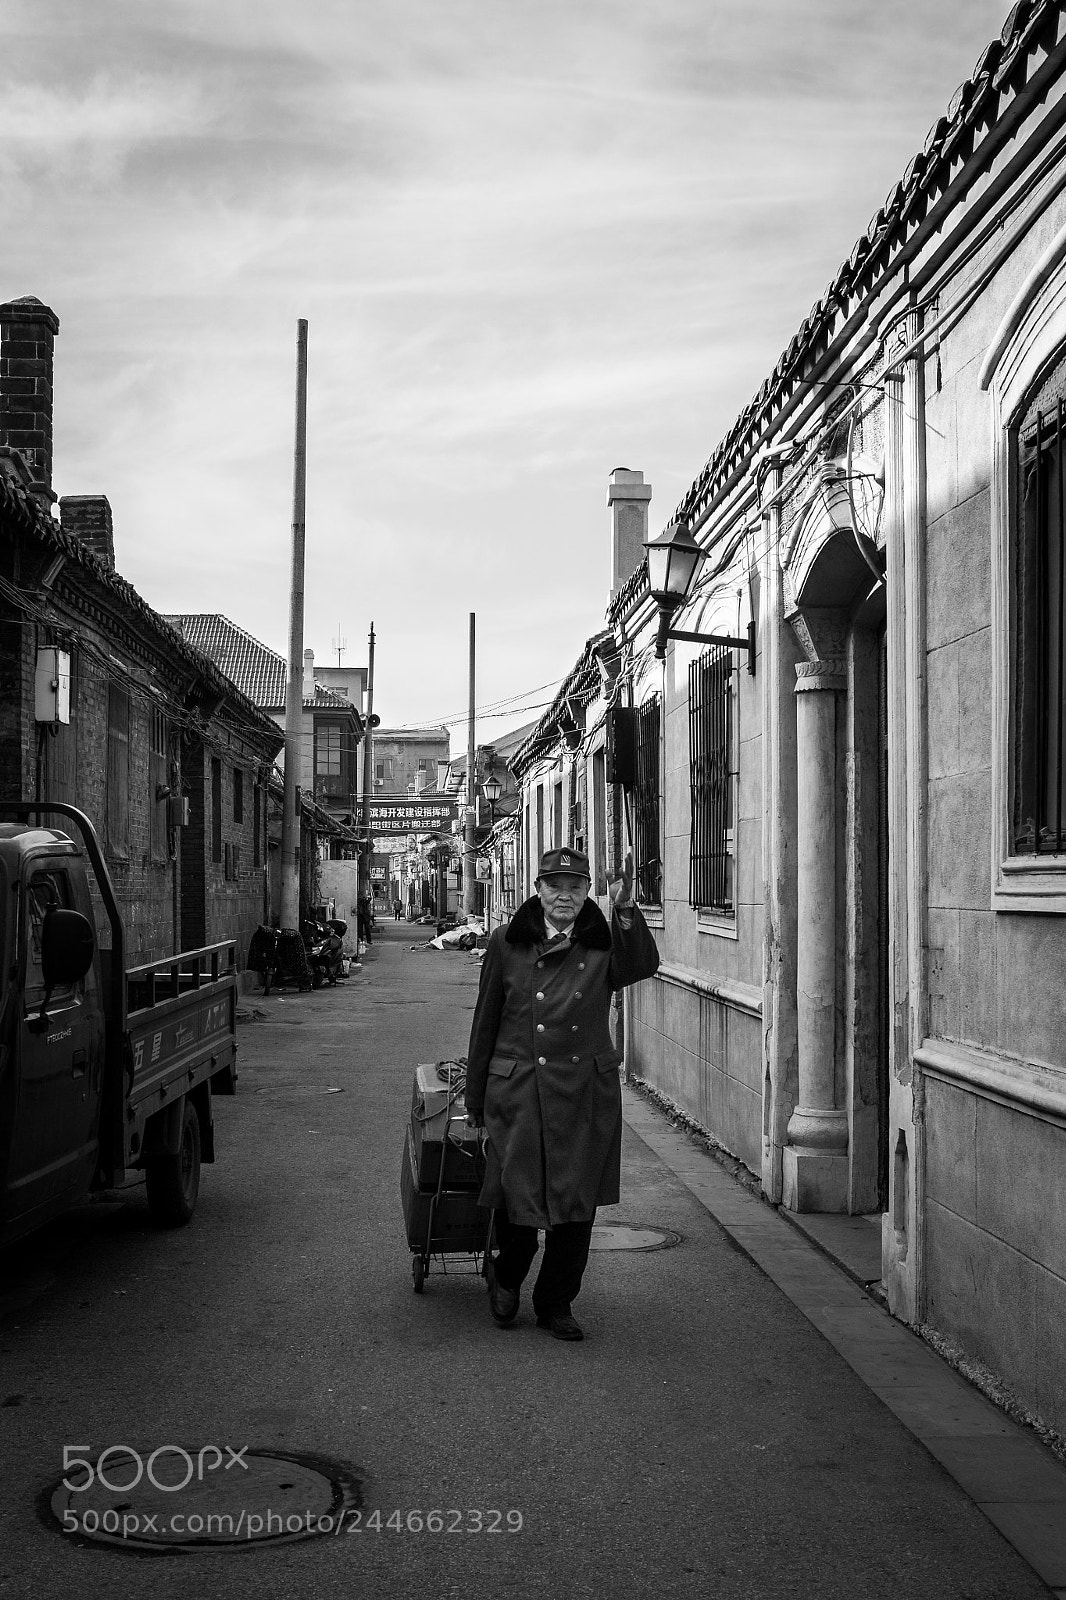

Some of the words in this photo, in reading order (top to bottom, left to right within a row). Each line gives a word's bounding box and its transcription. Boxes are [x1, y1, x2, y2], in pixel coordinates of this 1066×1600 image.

[357, 806, 451, 818] 滨海开发建设指挥部
[369, 820, 442, 829] 阳街区片搬迁部
